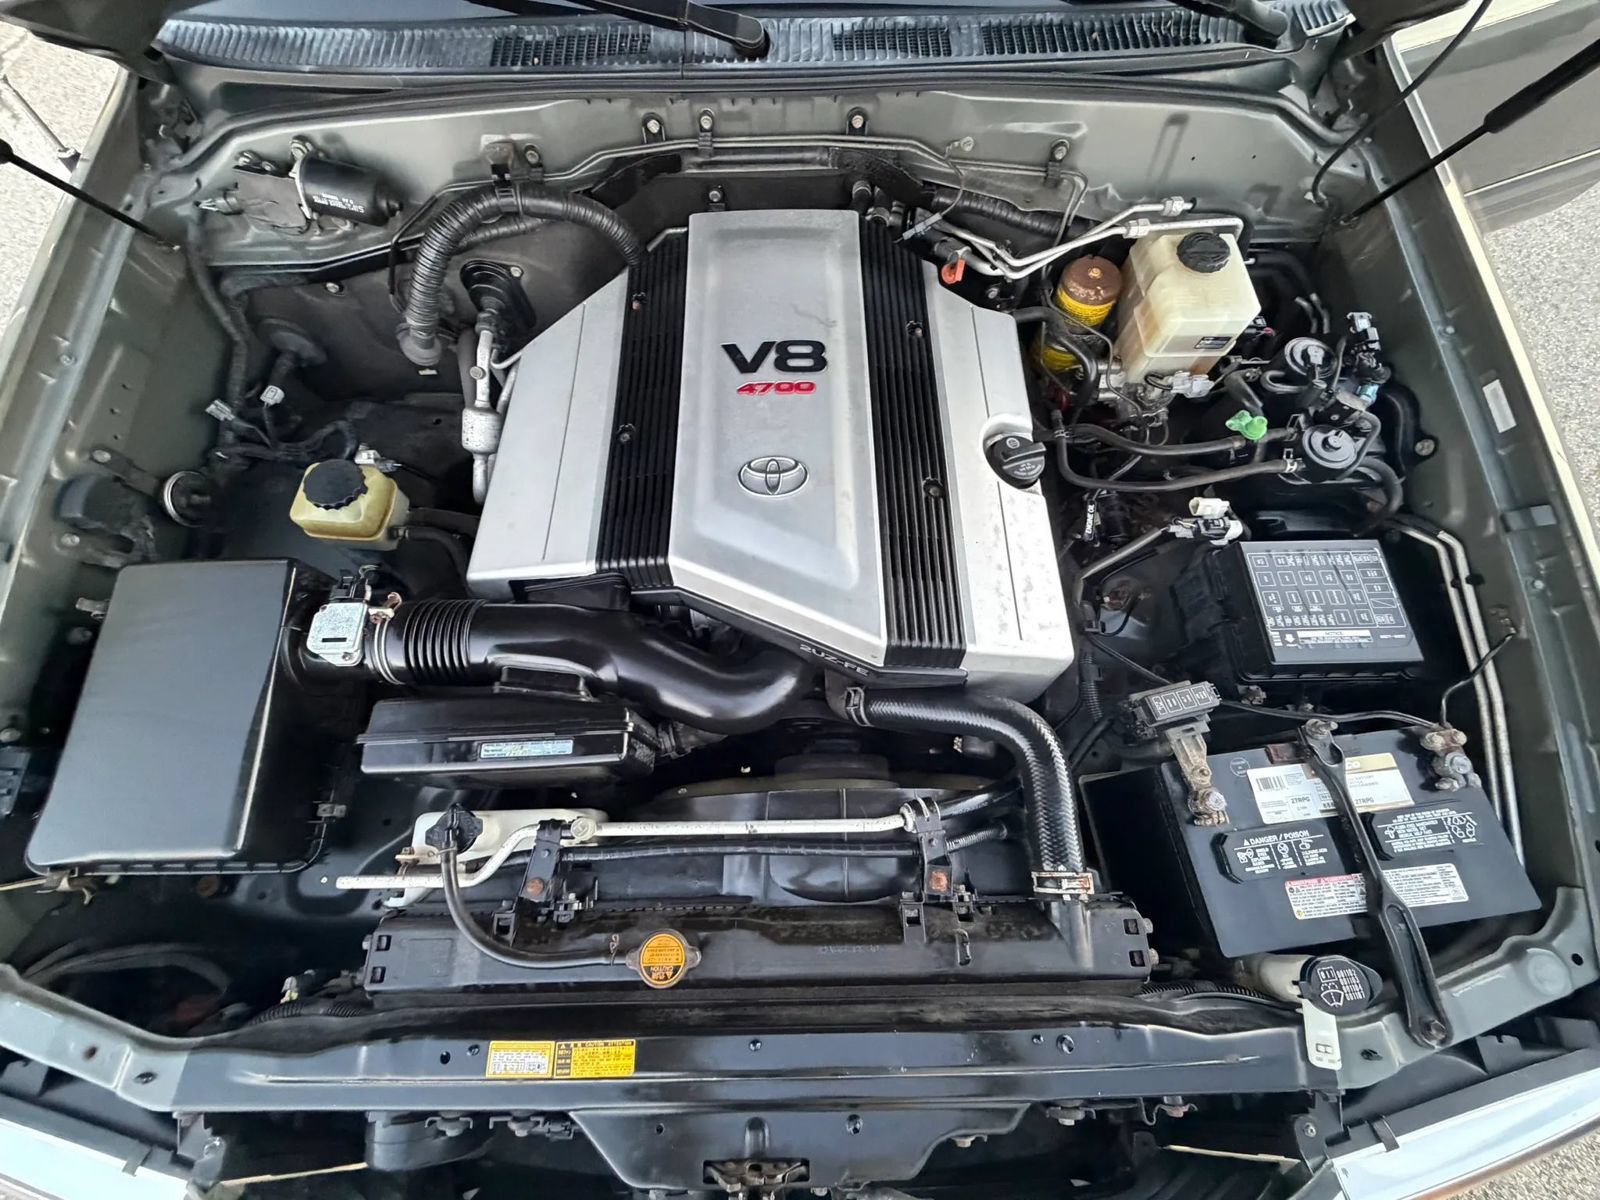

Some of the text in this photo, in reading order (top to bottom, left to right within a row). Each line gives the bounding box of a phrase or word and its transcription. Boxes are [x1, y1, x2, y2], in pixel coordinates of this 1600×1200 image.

[720, 340, 828, 374] V8
[736, 381, 816, 395] 4700
[799, 643, 870, 677] 2UZ-FE
[1249, 834, 1278, 845] DANGER
[1284, 830, 1310, 840] POISON
